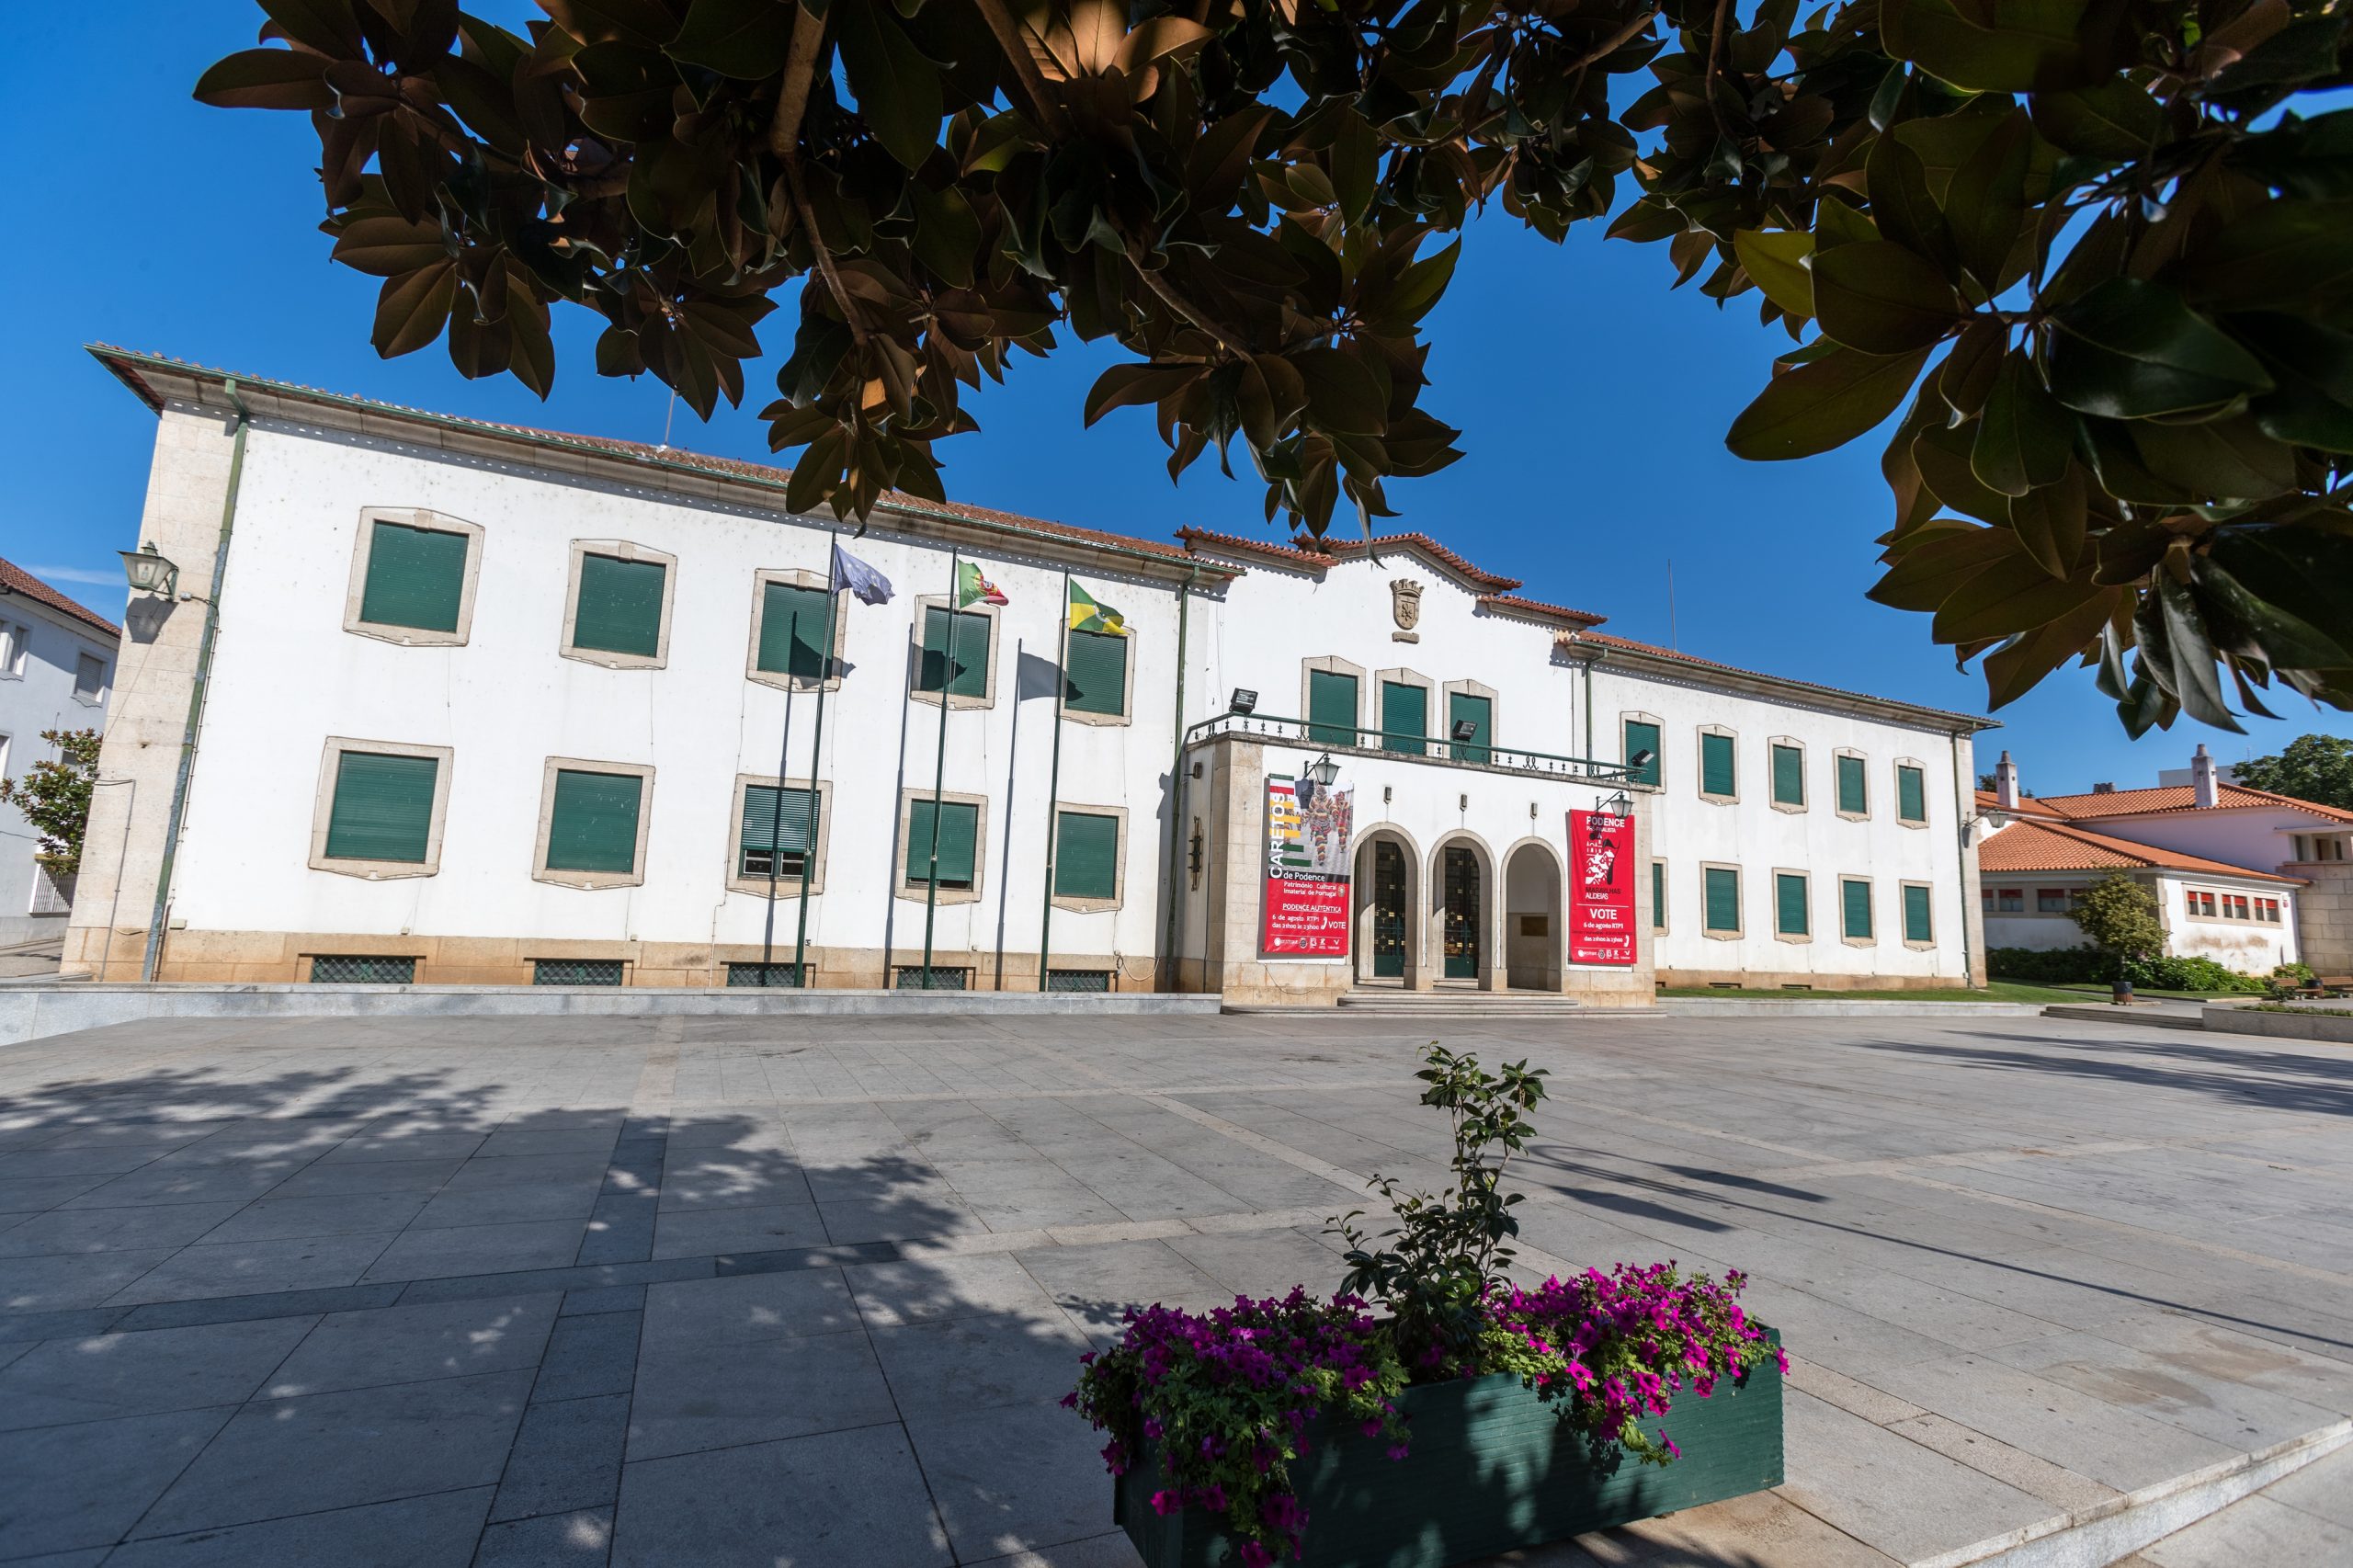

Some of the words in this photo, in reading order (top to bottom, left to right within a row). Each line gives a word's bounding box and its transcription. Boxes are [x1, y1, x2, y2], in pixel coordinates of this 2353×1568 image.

[1586, 816, 1625, 827] PODENCE
[1270, 793, 1285, 878] CARETOS
[1295, 872, 1325, 881] Podence
[1590, 908, 1617, 919] VOTE
